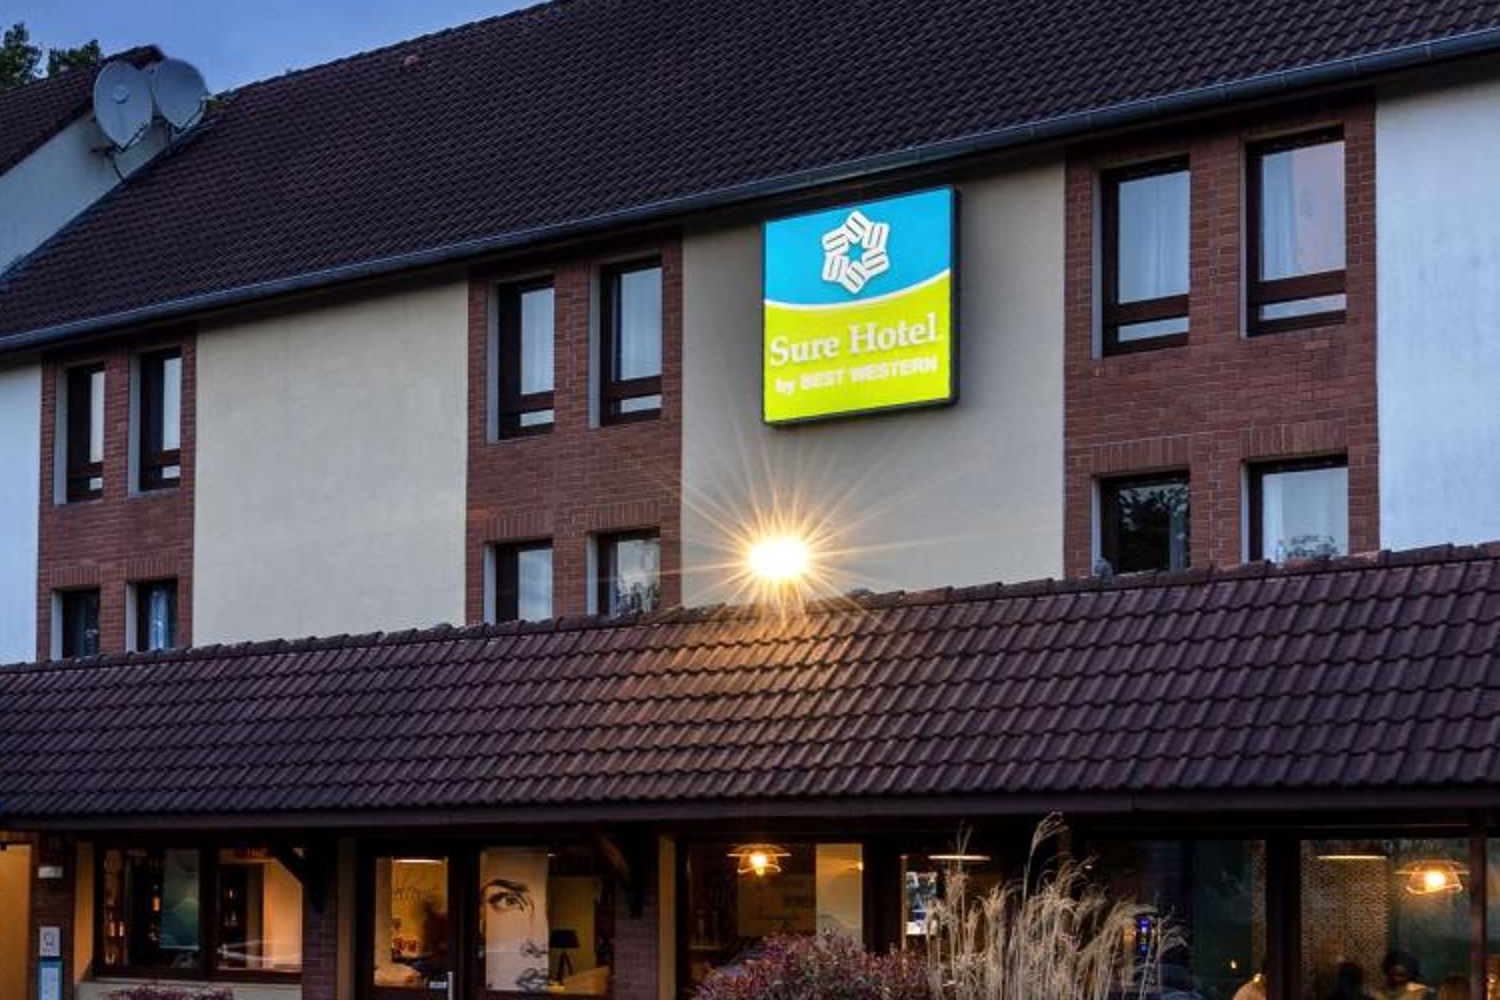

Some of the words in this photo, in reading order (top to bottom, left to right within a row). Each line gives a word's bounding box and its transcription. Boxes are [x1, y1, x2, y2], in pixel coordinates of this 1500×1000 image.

[771, 335, 841, 366] Sure
[849, 311, 938, 354] Hotel
[775, 376, 796, 396] by
[801, 367, 846, 390] BEST
[851, 356, 938, 382] WESTERN
